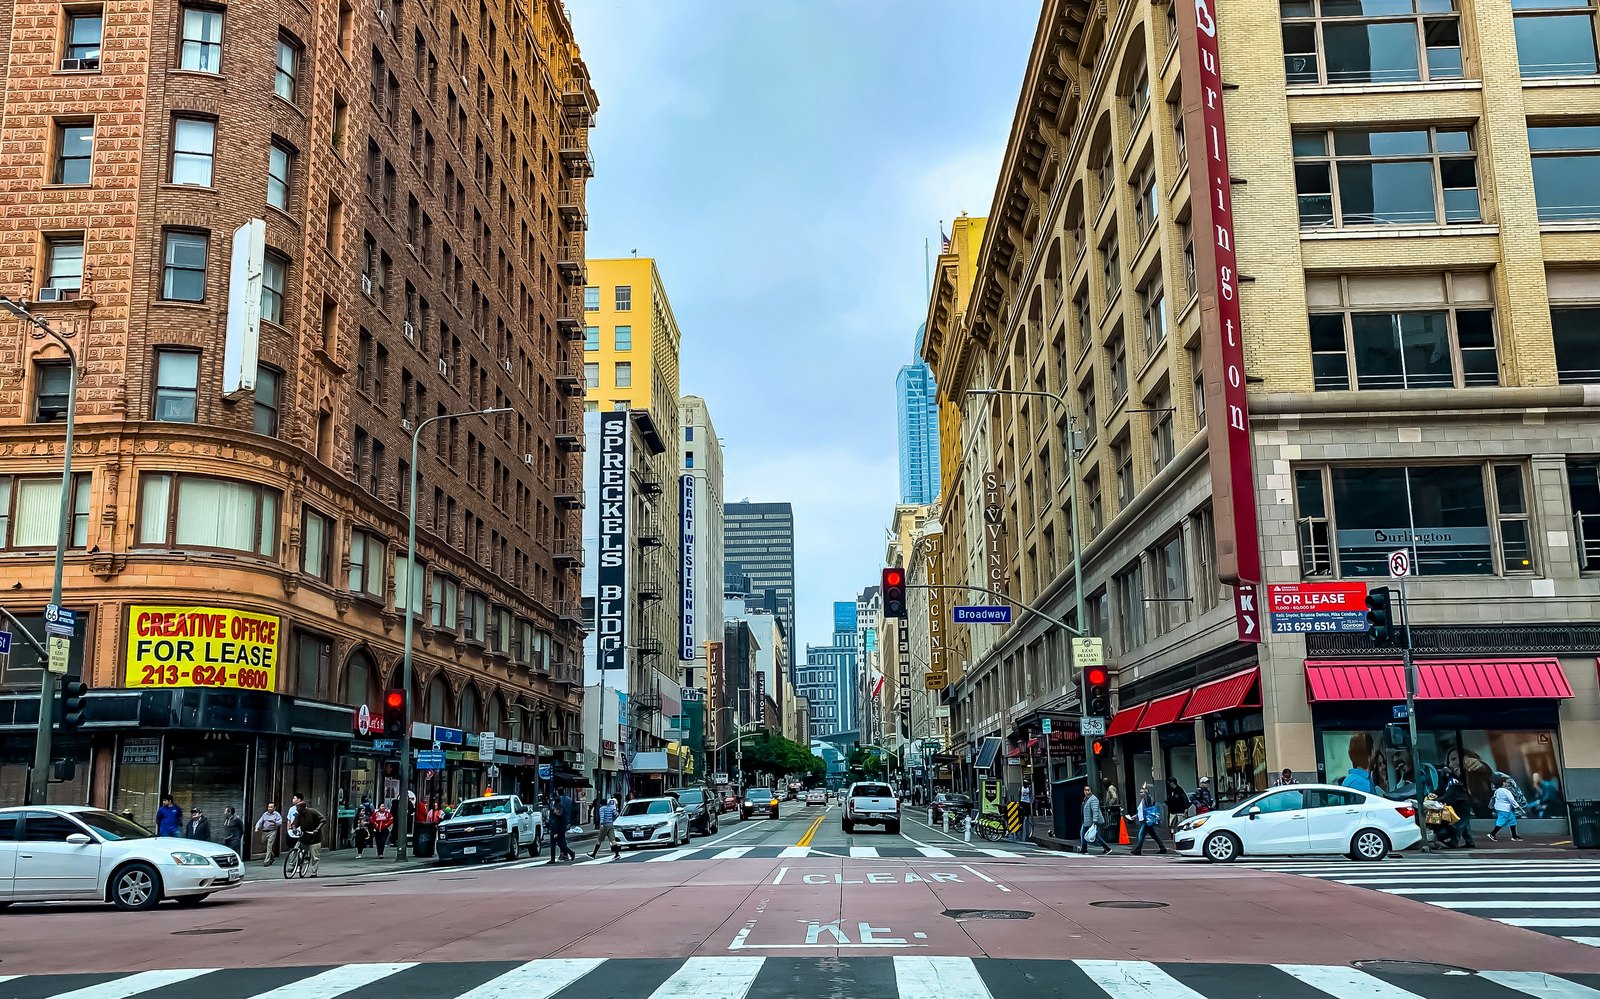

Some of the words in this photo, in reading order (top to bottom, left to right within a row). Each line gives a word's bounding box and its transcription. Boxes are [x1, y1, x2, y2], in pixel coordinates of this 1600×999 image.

[1194, 0, 1245, 431] Burlington
[601, 420, 624, 567] SPRECKELS
[685, 476, 693, 530] GREAT
[1374, 530, 1452, 544] Burlington
[684, 534, 694, 610] WESTERN
[987, 524, 1001, 606] VINCEN
[47, 609, 57, 620] 66
[928, 556, 941, 664] VINCENT
[958, 609, 1007, 621] Broadway
[1274, 594, 1301, 605] FOR
[1304, 593, 1346, 604] LEASE
[136, 611, 227, 639] CREATIVE
[230, 615, 276, 645] OFFICE
[600, 585, 622, 662] BLDG.
[685, 614, 693, 659] BLDG
[1277, 622, 1292, 632] 213
[1294, 622, 1312, 632] 629
[1314, 621, 1337, 631] 6514
[136, 640, 195, 662] FOR
[204, 641, 273, 668] LEASE
[140, 664, 268, 690] 213-624-6600
[709, 651, 718, 733] JEWELRY
[801, 871, 966, 884] CLEAR
